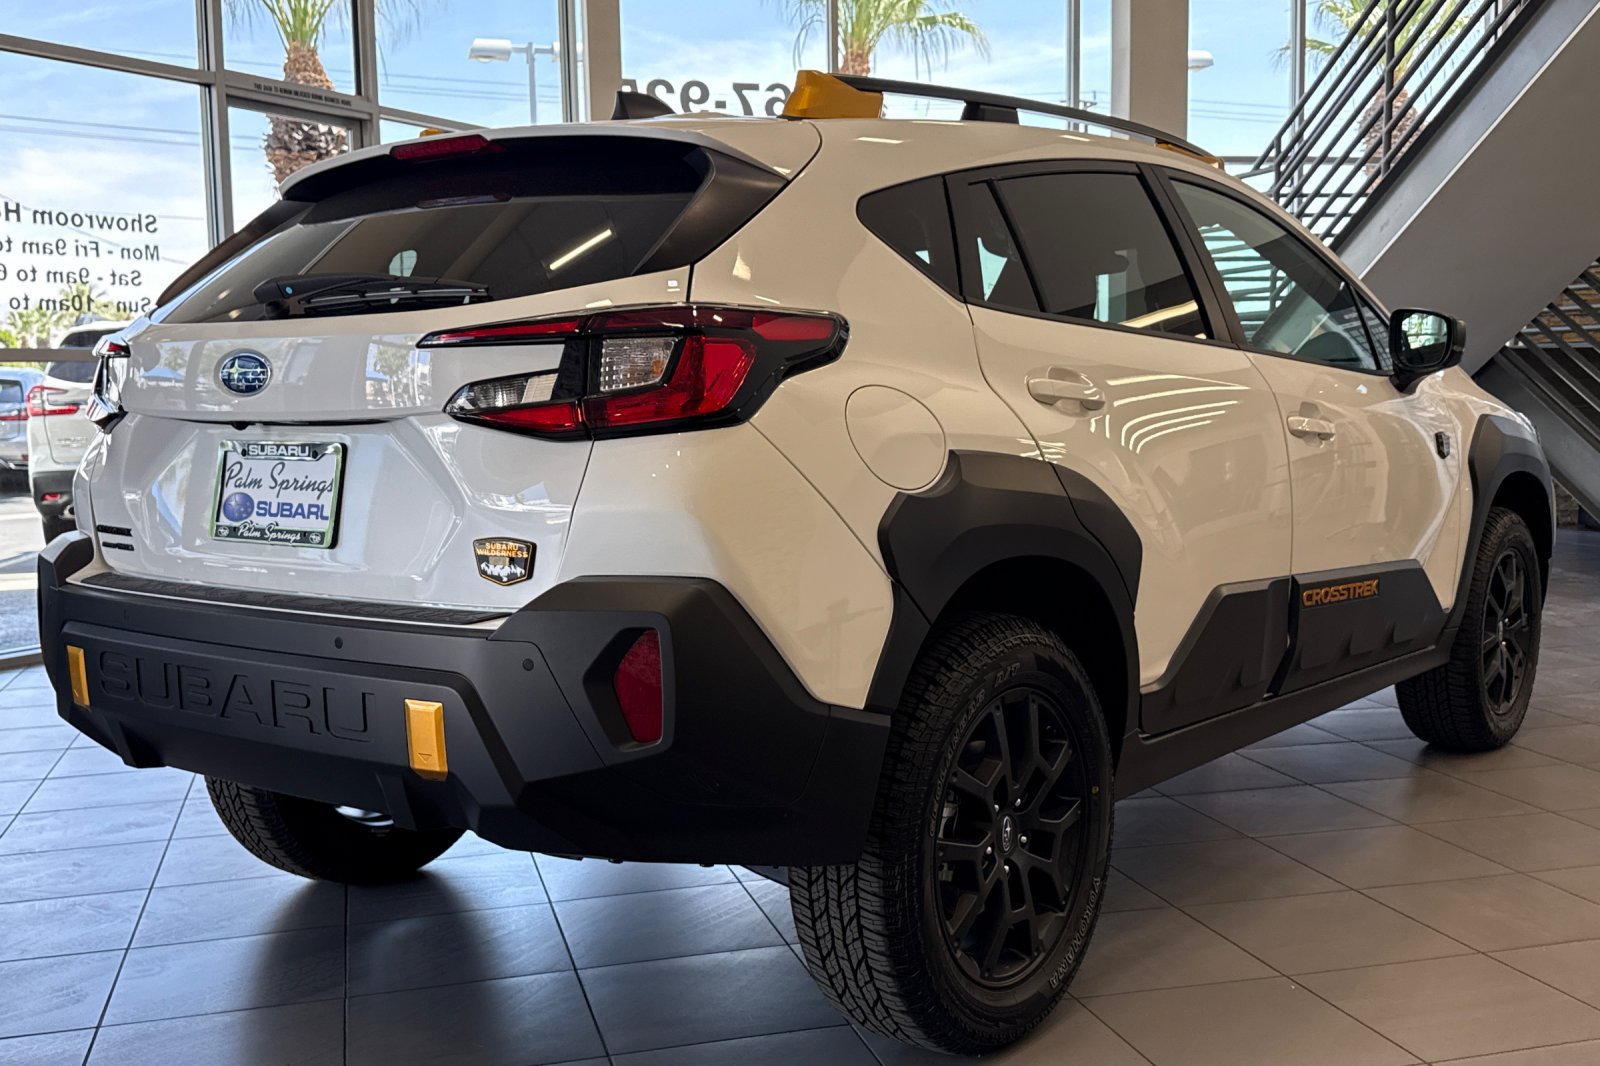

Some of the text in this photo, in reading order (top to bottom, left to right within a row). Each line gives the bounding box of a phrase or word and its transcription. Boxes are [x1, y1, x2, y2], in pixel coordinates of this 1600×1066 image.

[248, 445, 309, 456] SUBARU
[225, 461, 334, 500] Palm Springs
[238, 522, 301, 544] Palm Springs
[476, 547, 528, 558] WILDERNESS
[486, 542, 519, 550] SUBARU
[1303, 579, 1378, 607] CROSSTREK
[100, 651, 377, 742] SUBARU
[1048, 876, 1102, 989] YOKOHAMA
